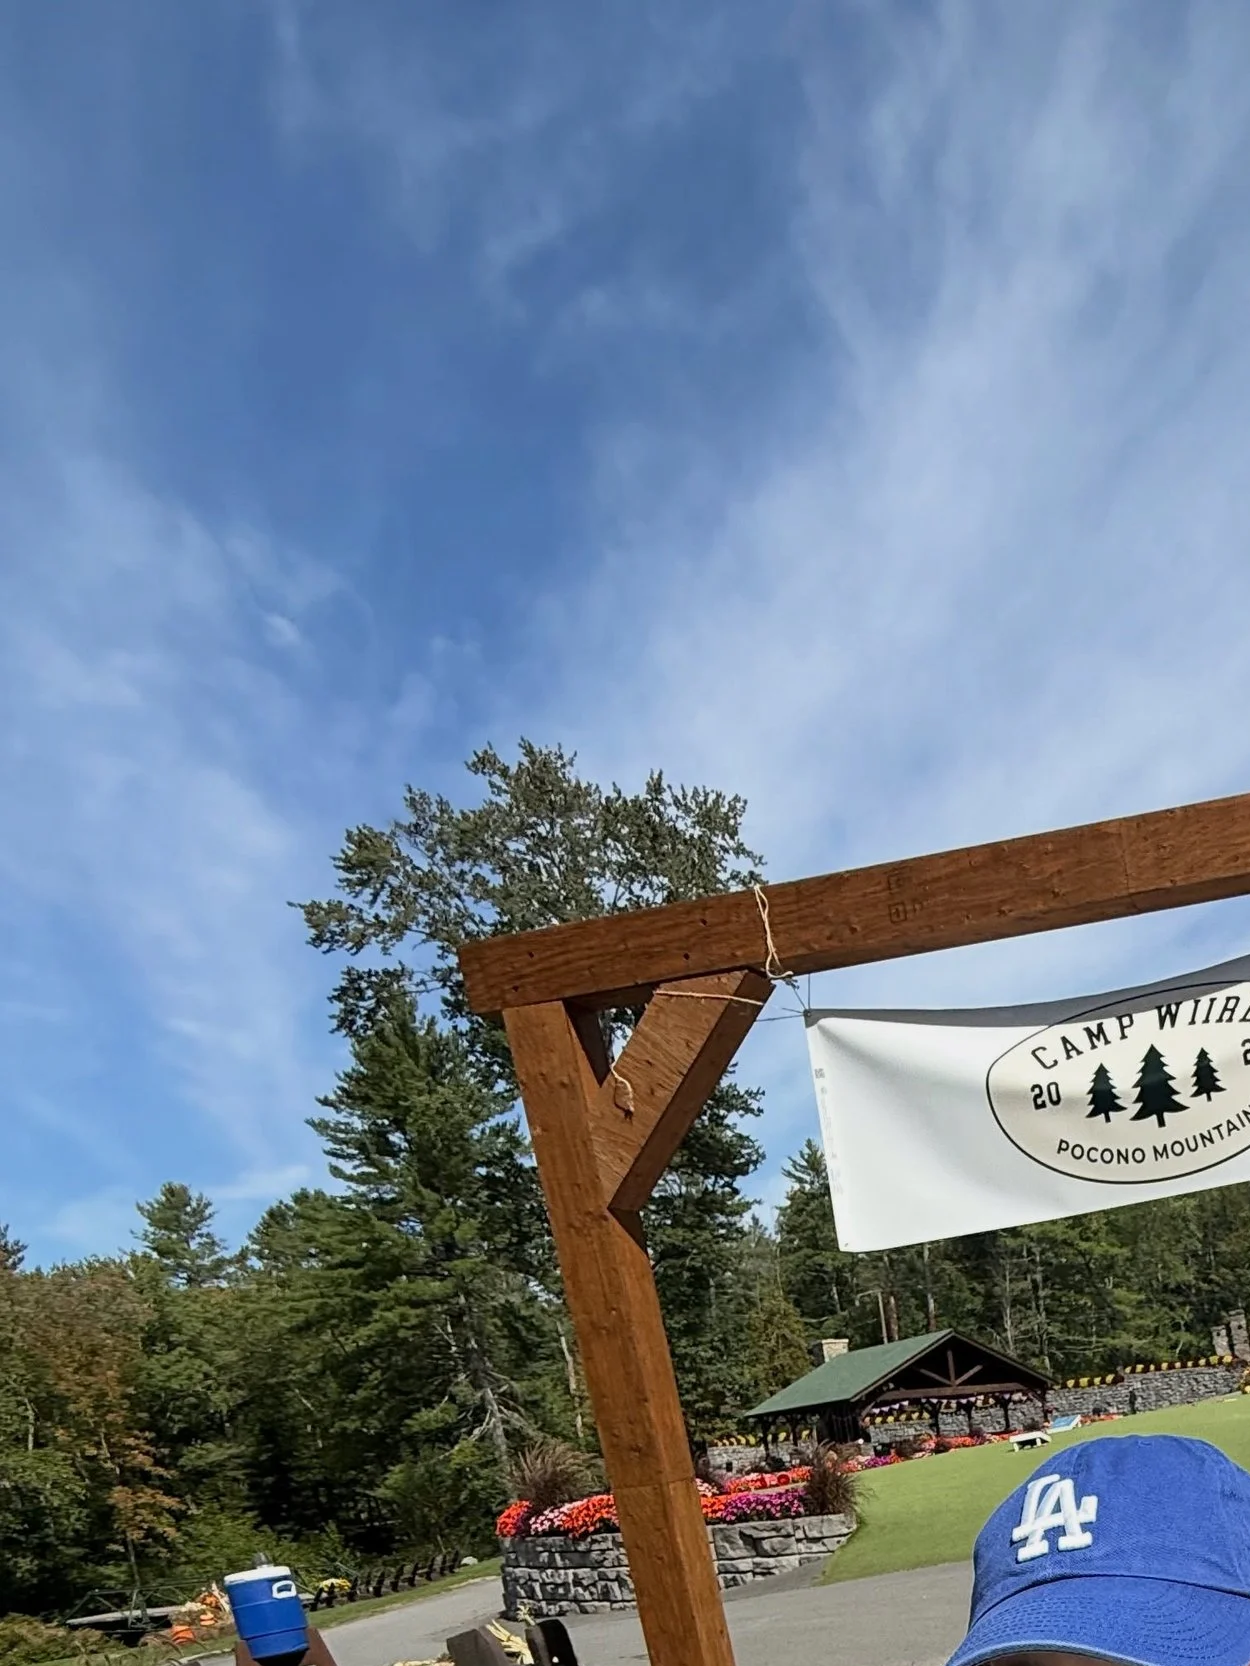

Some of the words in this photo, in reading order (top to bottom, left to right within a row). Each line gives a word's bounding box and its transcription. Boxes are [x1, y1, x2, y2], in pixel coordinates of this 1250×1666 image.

[1030, 1013, 1135, 1070] CAMP
[1030, 1081, 1062, 1111] 20
[1056, 1138, 1146, 1165] POCONO
[1011, 1473, 1099, 1563] LA
